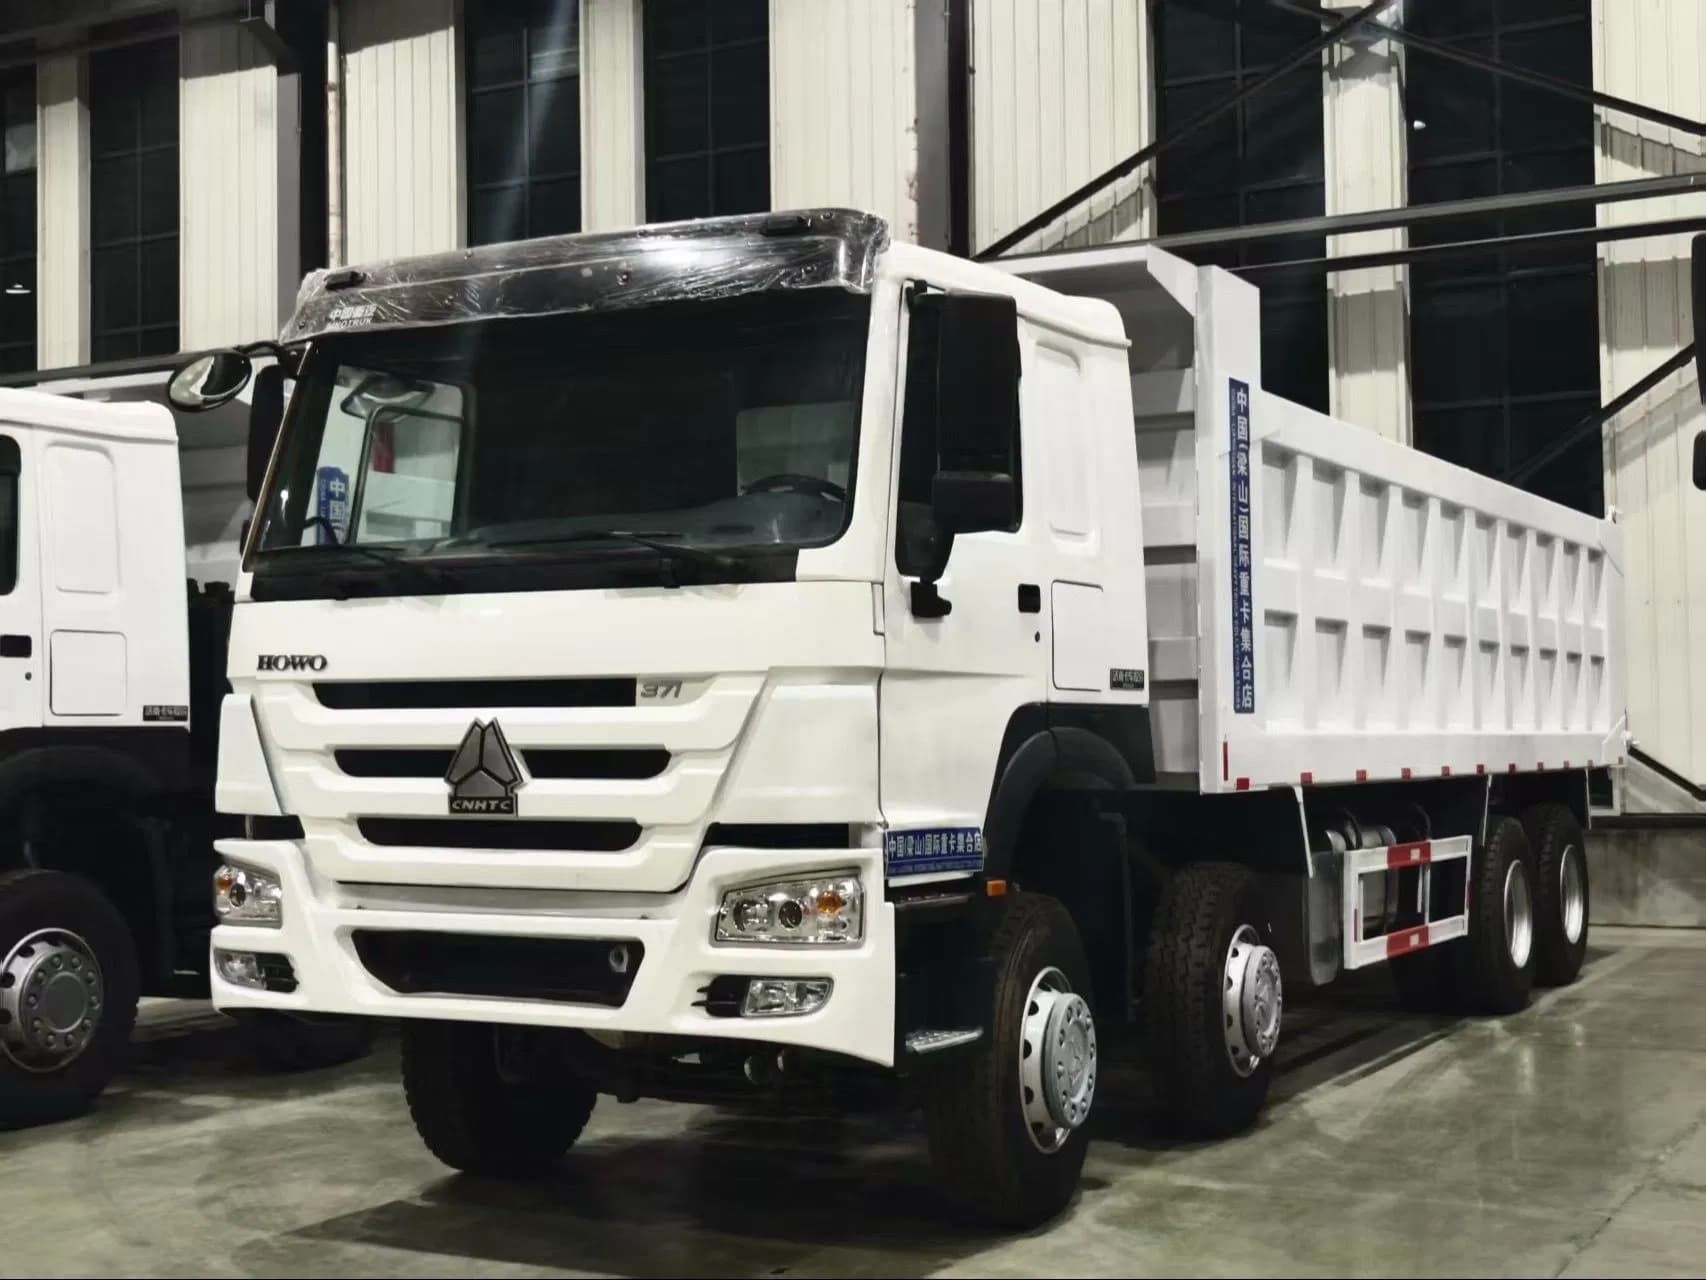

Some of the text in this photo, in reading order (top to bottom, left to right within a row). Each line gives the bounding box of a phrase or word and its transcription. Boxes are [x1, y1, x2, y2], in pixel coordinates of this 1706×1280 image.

[257, 655, 328, 671] HOWO
[640, 680, 682, 698] 371
[452, 800, 511, 812] CNHTC
